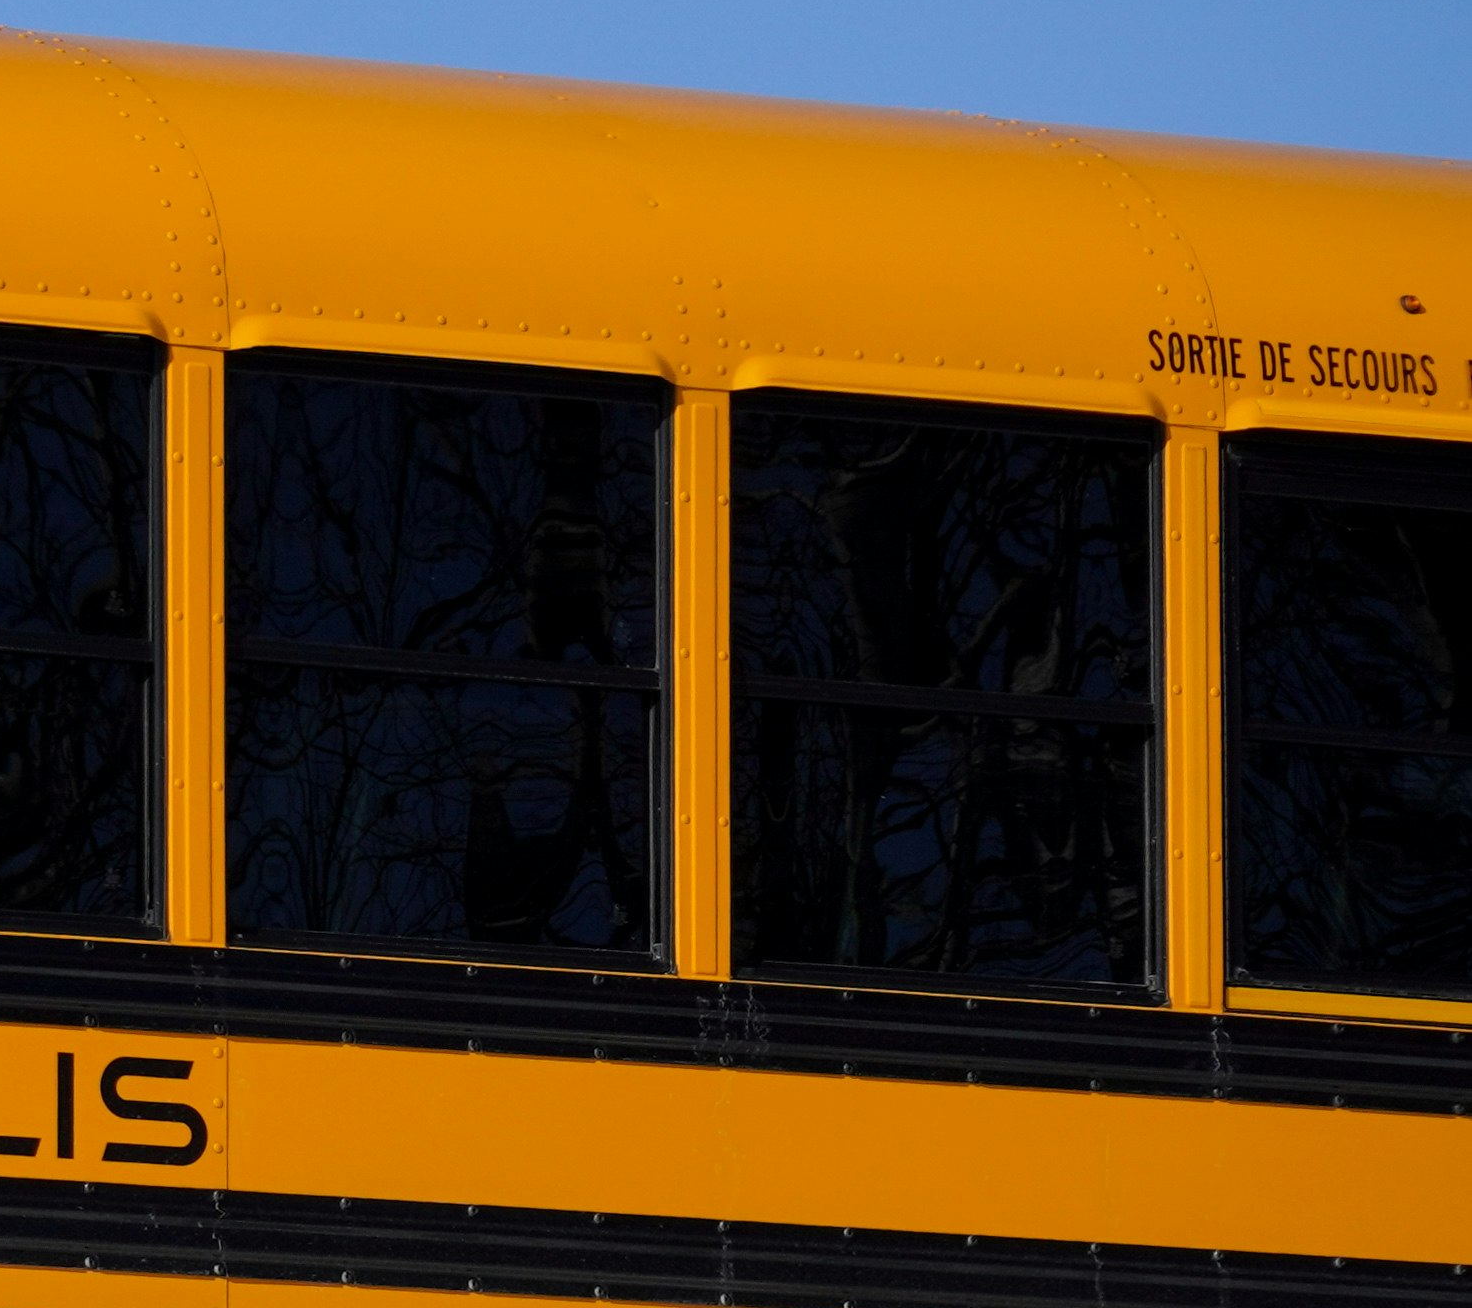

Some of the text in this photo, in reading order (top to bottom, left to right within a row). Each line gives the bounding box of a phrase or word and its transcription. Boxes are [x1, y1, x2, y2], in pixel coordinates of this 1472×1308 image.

[1147, 328, 1246, 379] SORTIE
[1258, 340, 1295, 383] DE
[1308, 344, 1438, 397] SECOURS
